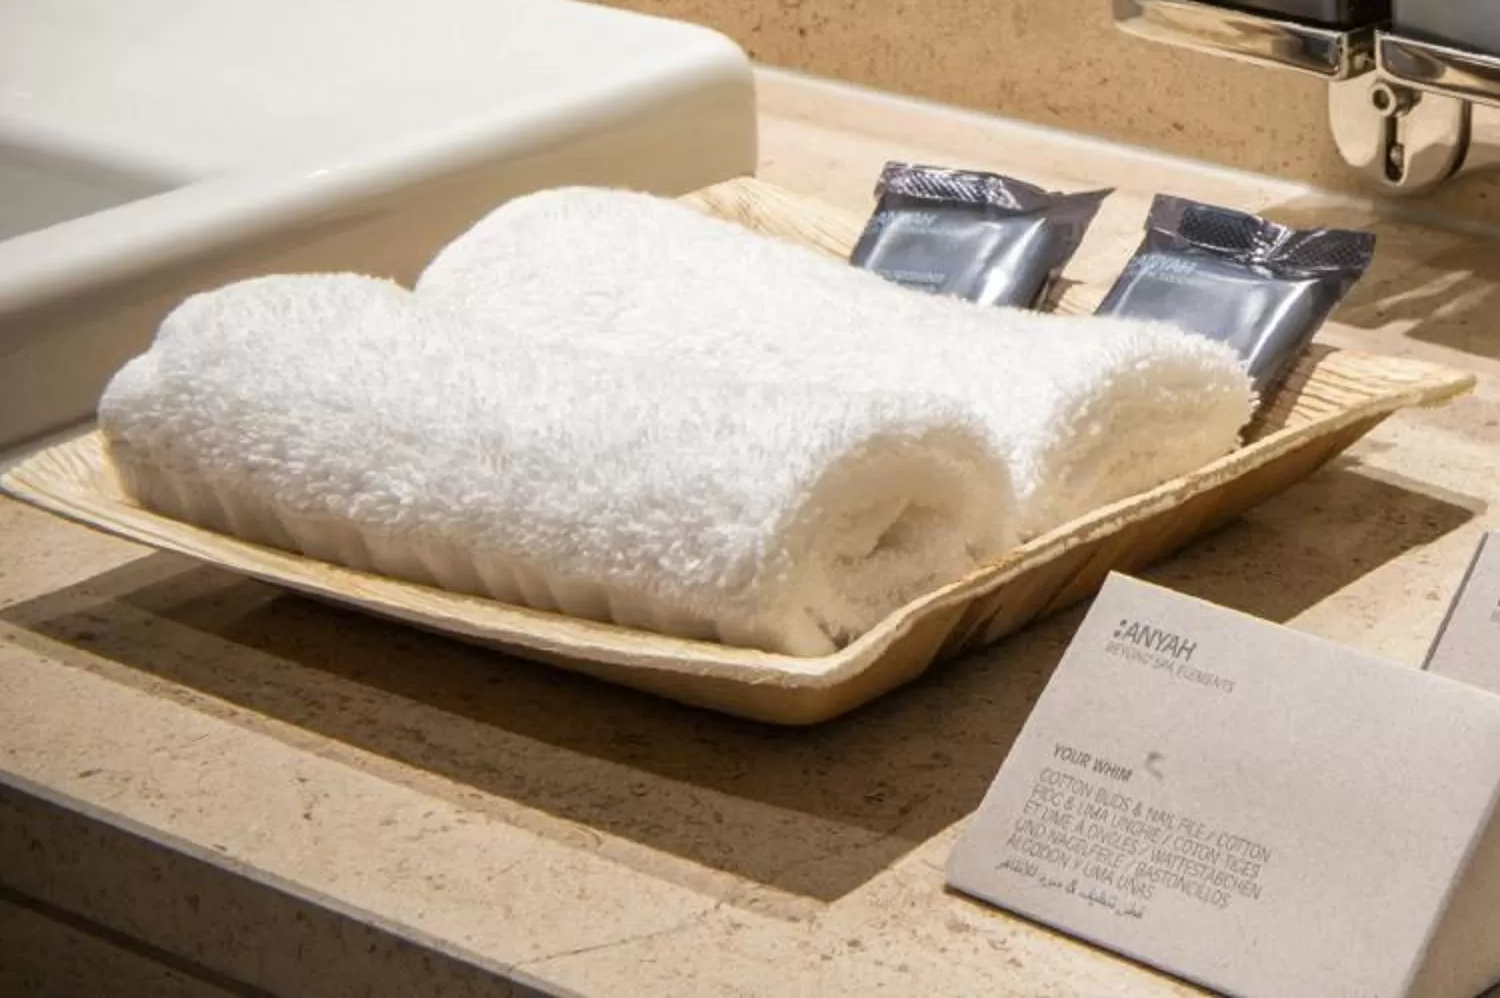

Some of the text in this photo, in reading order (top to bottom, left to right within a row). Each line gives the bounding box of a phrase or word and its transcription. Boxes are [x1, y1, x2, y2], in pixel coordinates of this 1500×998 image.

[1053, 742, 1134, 783] YOUR WHIM
[1040, 766, 1094, 798] COTTON
[1095, 787, 1134, 812] BUDS
[1216, 832, 1273, 863] COTTON
